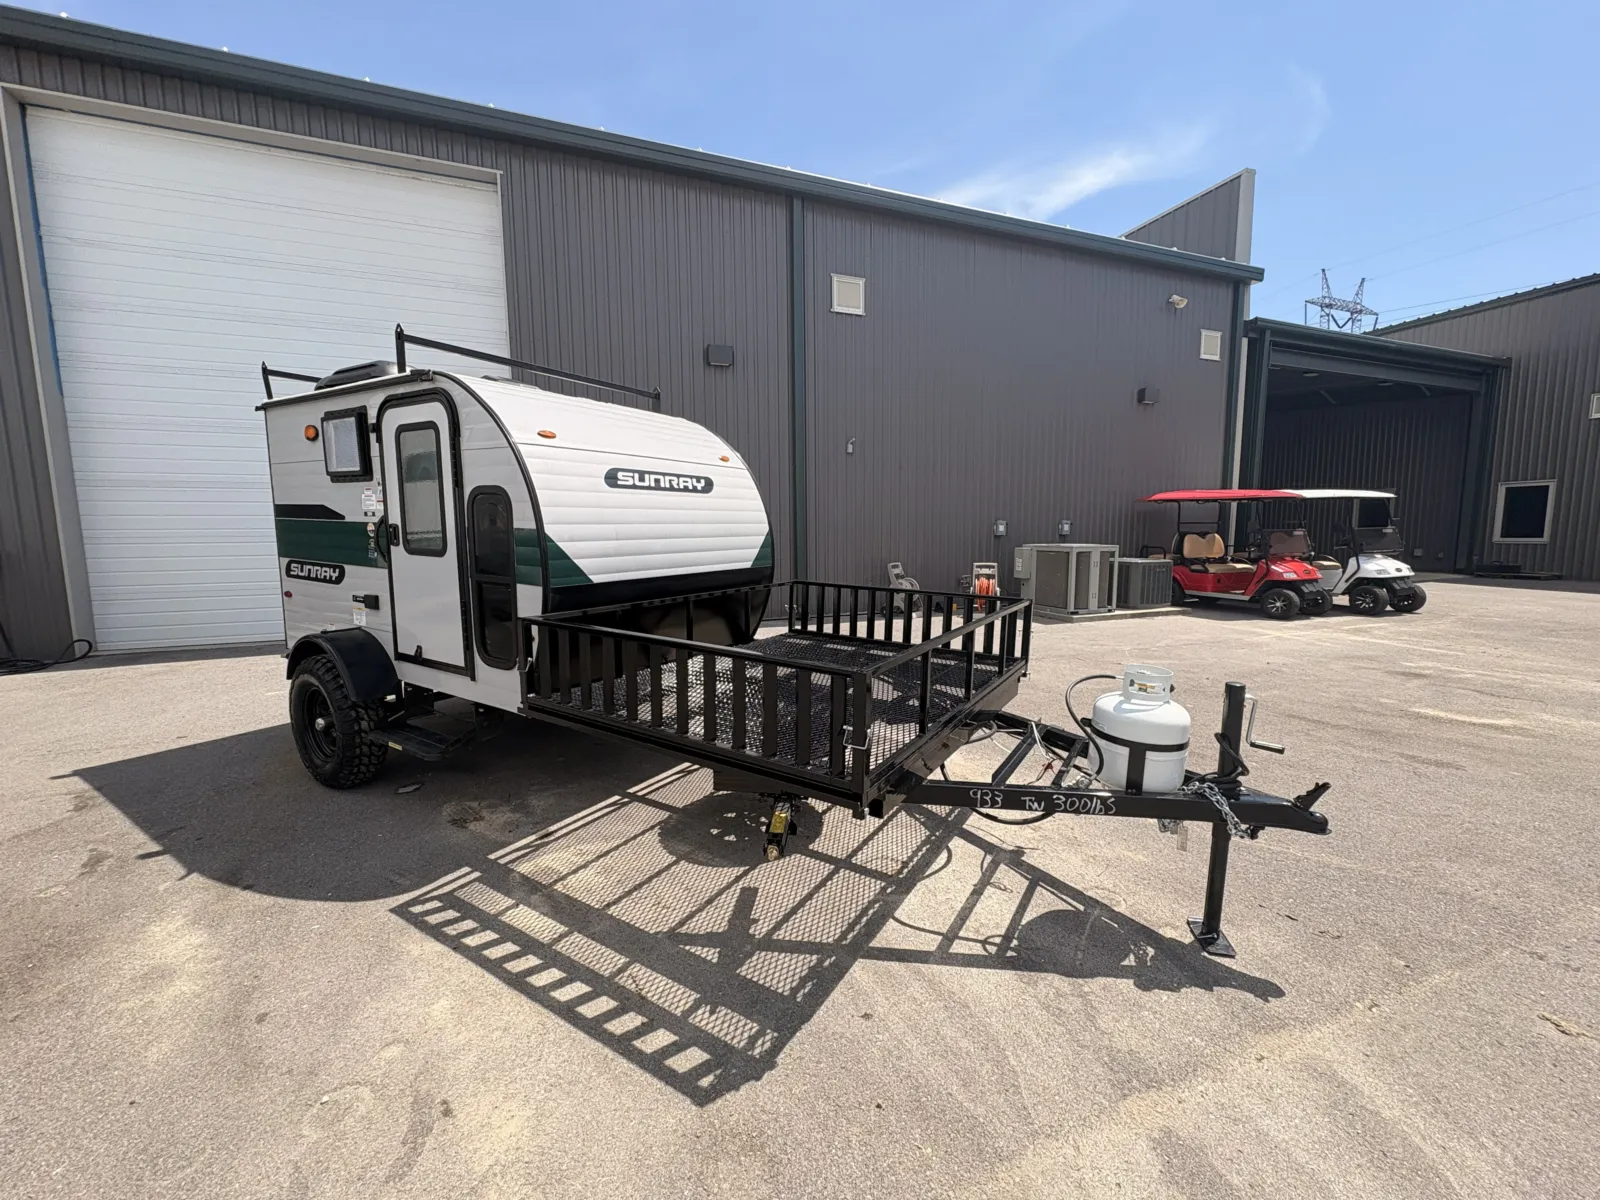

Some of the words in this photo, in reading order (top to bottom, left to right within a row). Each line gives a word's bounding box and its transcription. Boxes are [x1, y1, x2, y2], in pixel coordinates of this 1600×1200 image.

[617, 471, 705, 490] SUNRAY
[290, 563, 339, 580] SUNRAY
[970, 788, 1003, 808] 933
